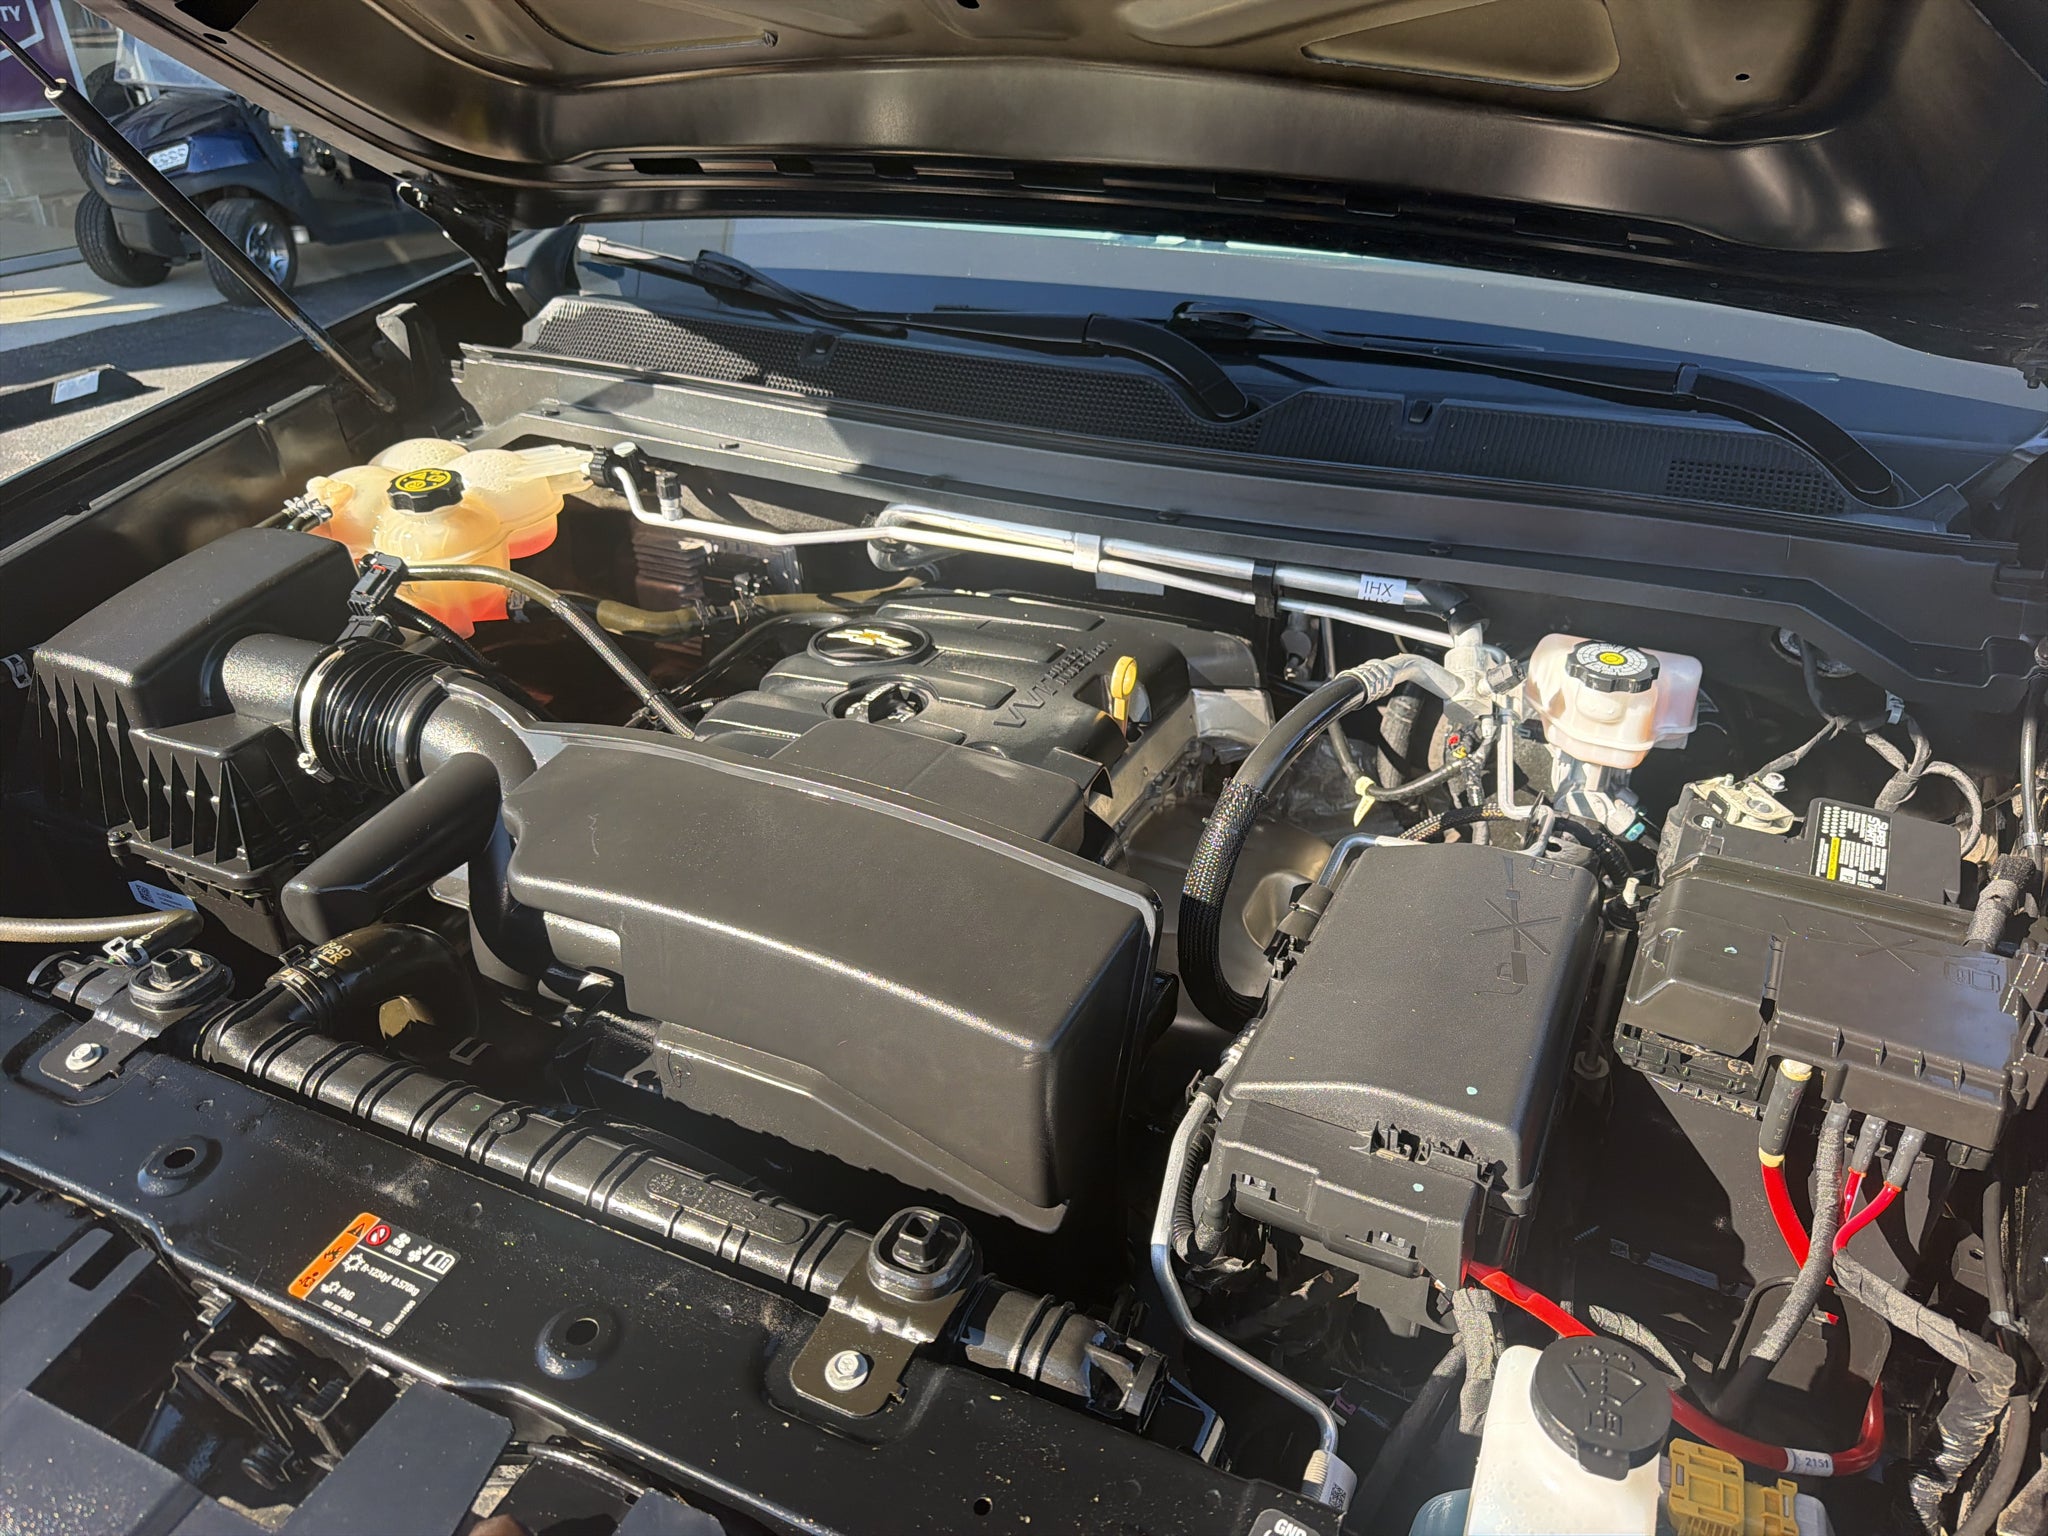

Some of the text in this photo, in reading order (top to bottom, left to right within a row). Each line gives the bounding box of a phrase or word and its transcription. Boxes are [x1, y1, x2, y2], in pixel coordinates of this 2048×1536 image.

[1864, 814, 1880, 847] START
[1876, 821, 1889, 848] SUPER
[384, 1246, 402, 1257] AUTO
[337, 1287, 356, 1302] PAG
